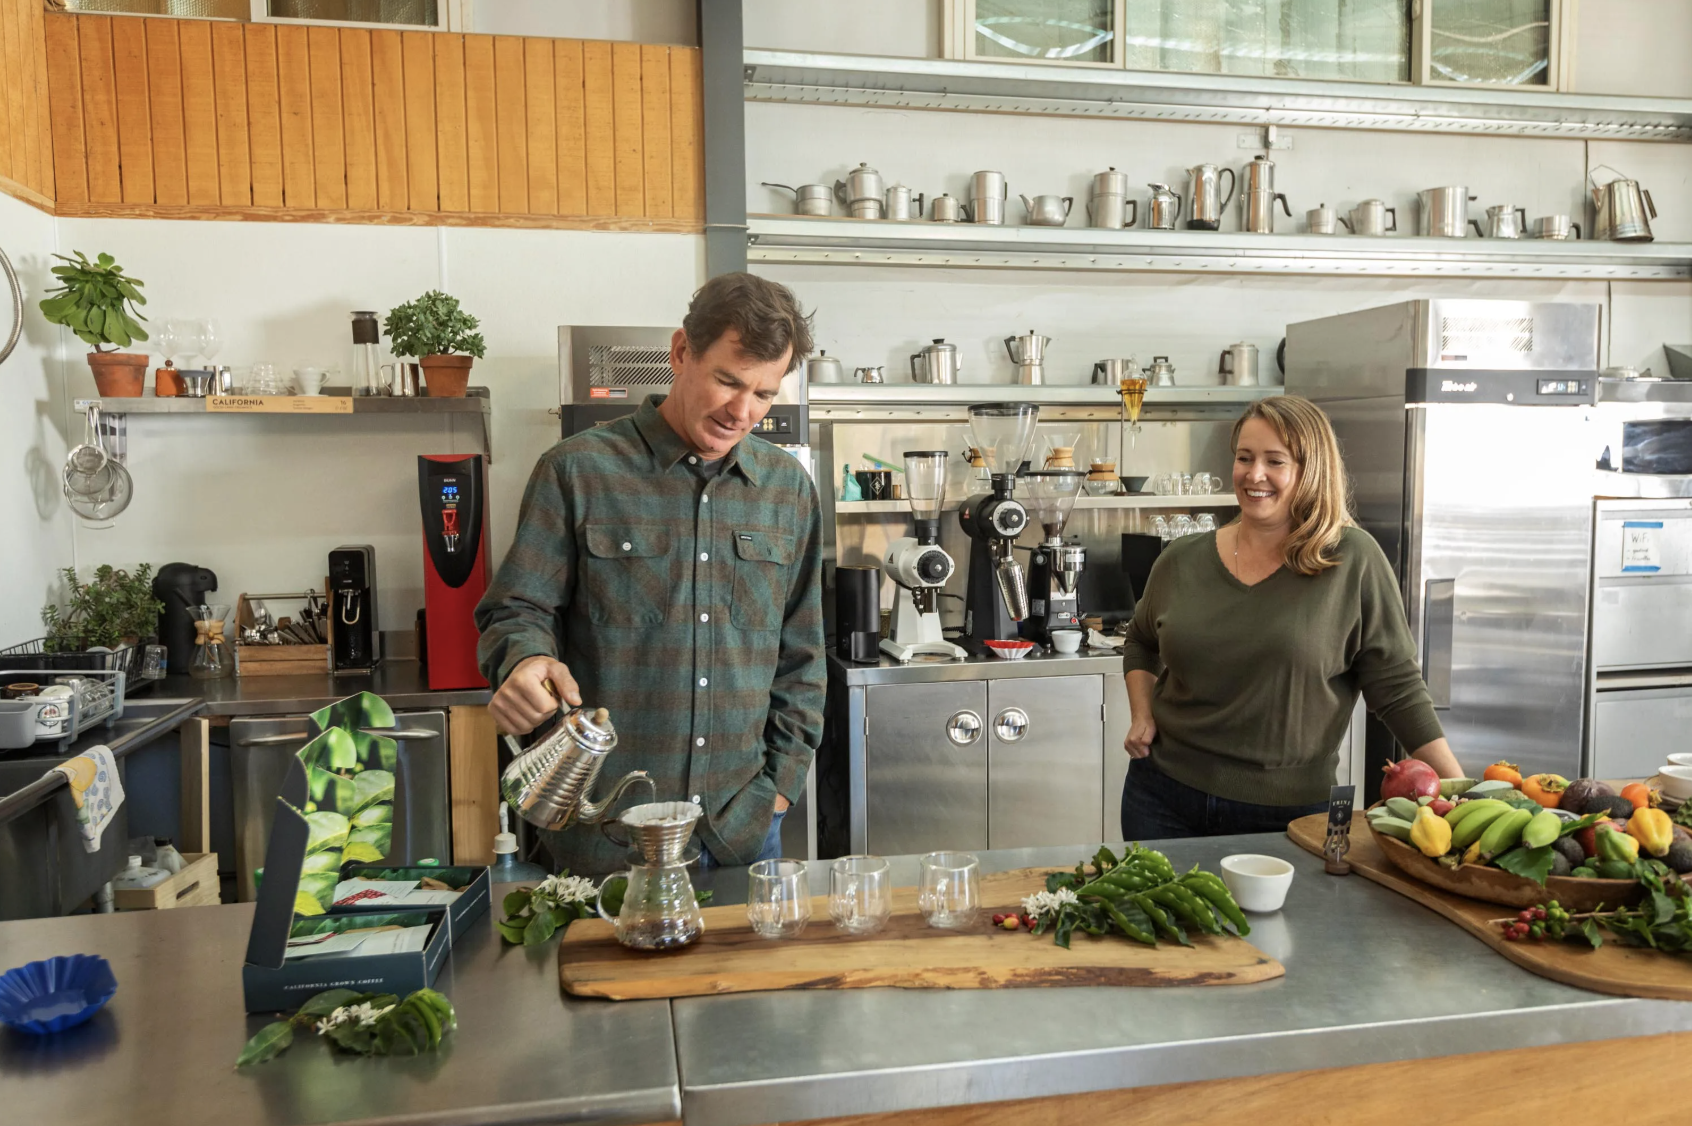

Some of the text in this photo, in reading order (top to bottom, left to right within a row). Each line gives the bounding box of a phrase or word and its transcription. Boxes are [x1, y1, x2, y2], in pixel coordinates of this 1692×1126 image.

[212, 398, 264, 406] CALIFORNIA
[442, 486, 458, 494] 205
[1631, 532, 1650, 543] WiFi
[283, 982, 328, 990] CALIFORNIA
[357, 977, 384, 985] COFFEE
